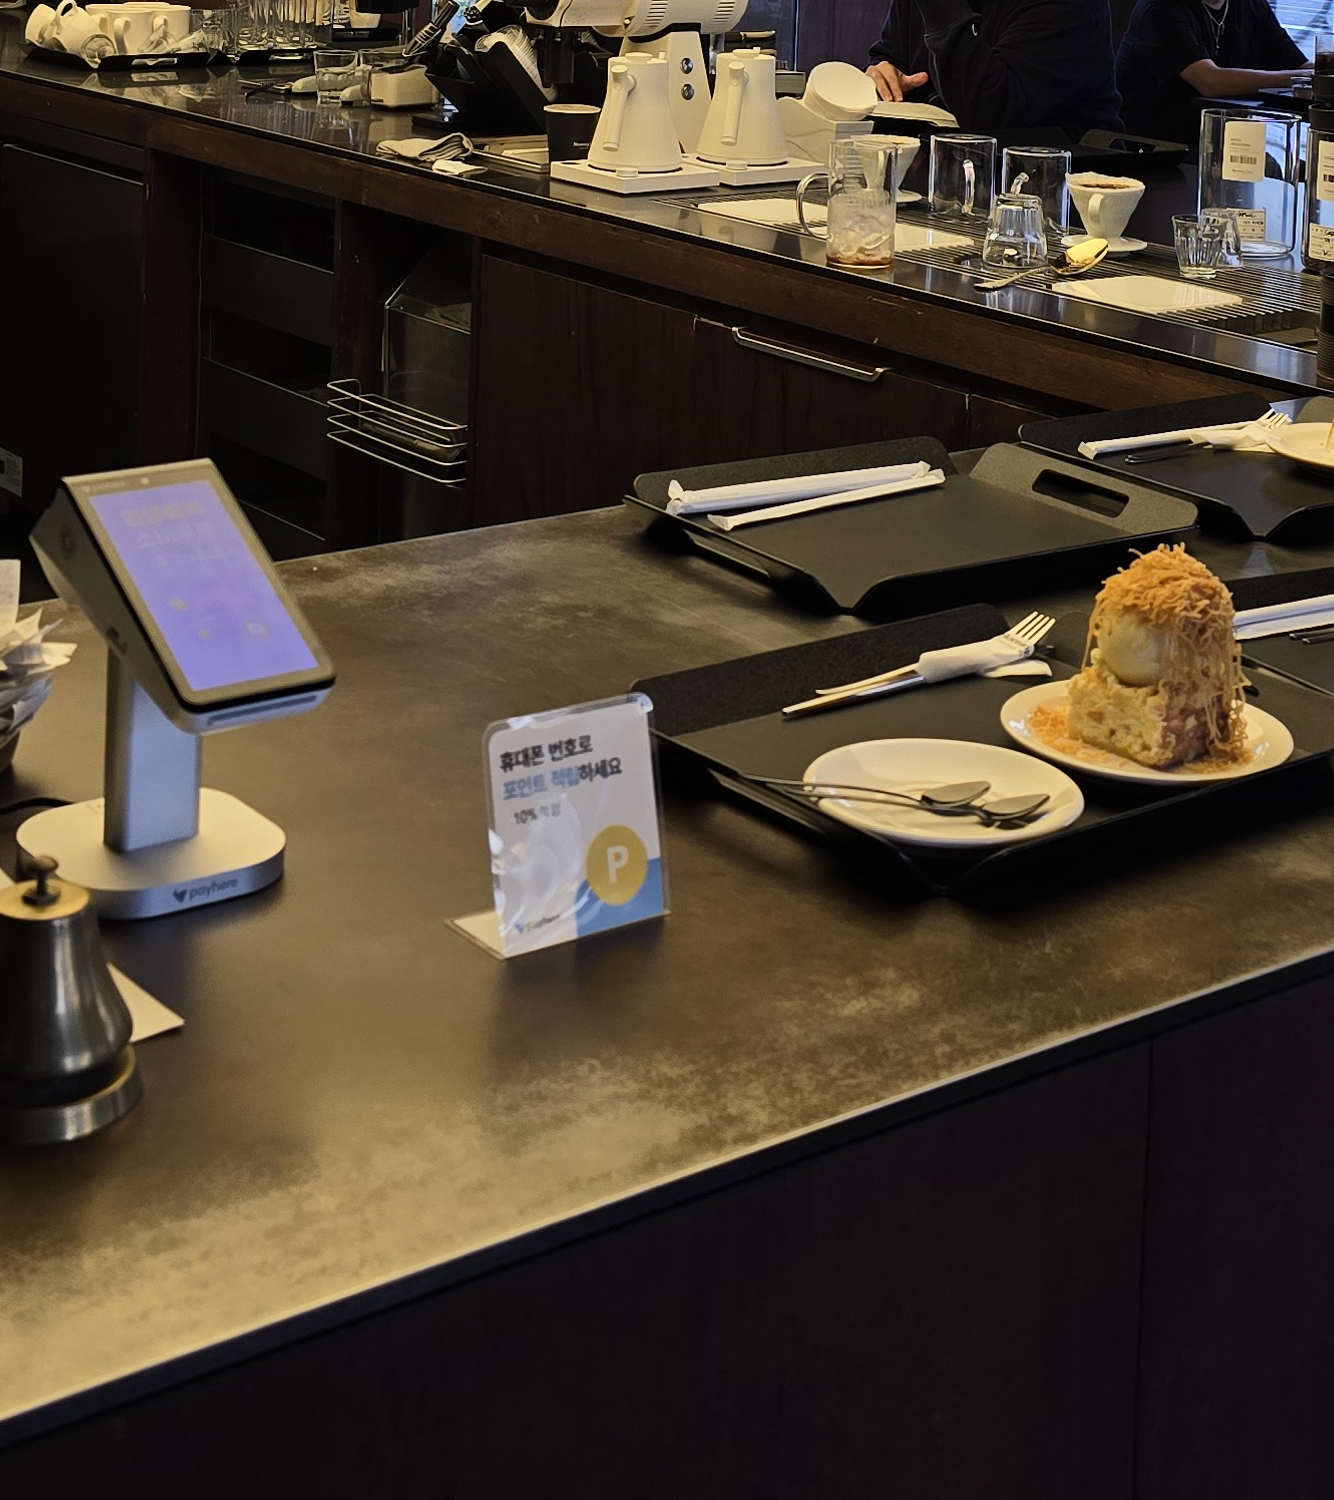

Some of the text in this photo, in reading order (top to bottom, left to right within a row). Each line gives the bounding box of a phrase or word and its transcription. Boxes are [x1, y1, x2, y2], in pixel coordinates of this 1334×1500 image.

[500, 734, 594, 773] 휴대폰 번호로
[503, 757, 623, 800] 포인트 적립하세요
[606, 844, 630, 883] P
[188, 875, 238, 902] payhere
